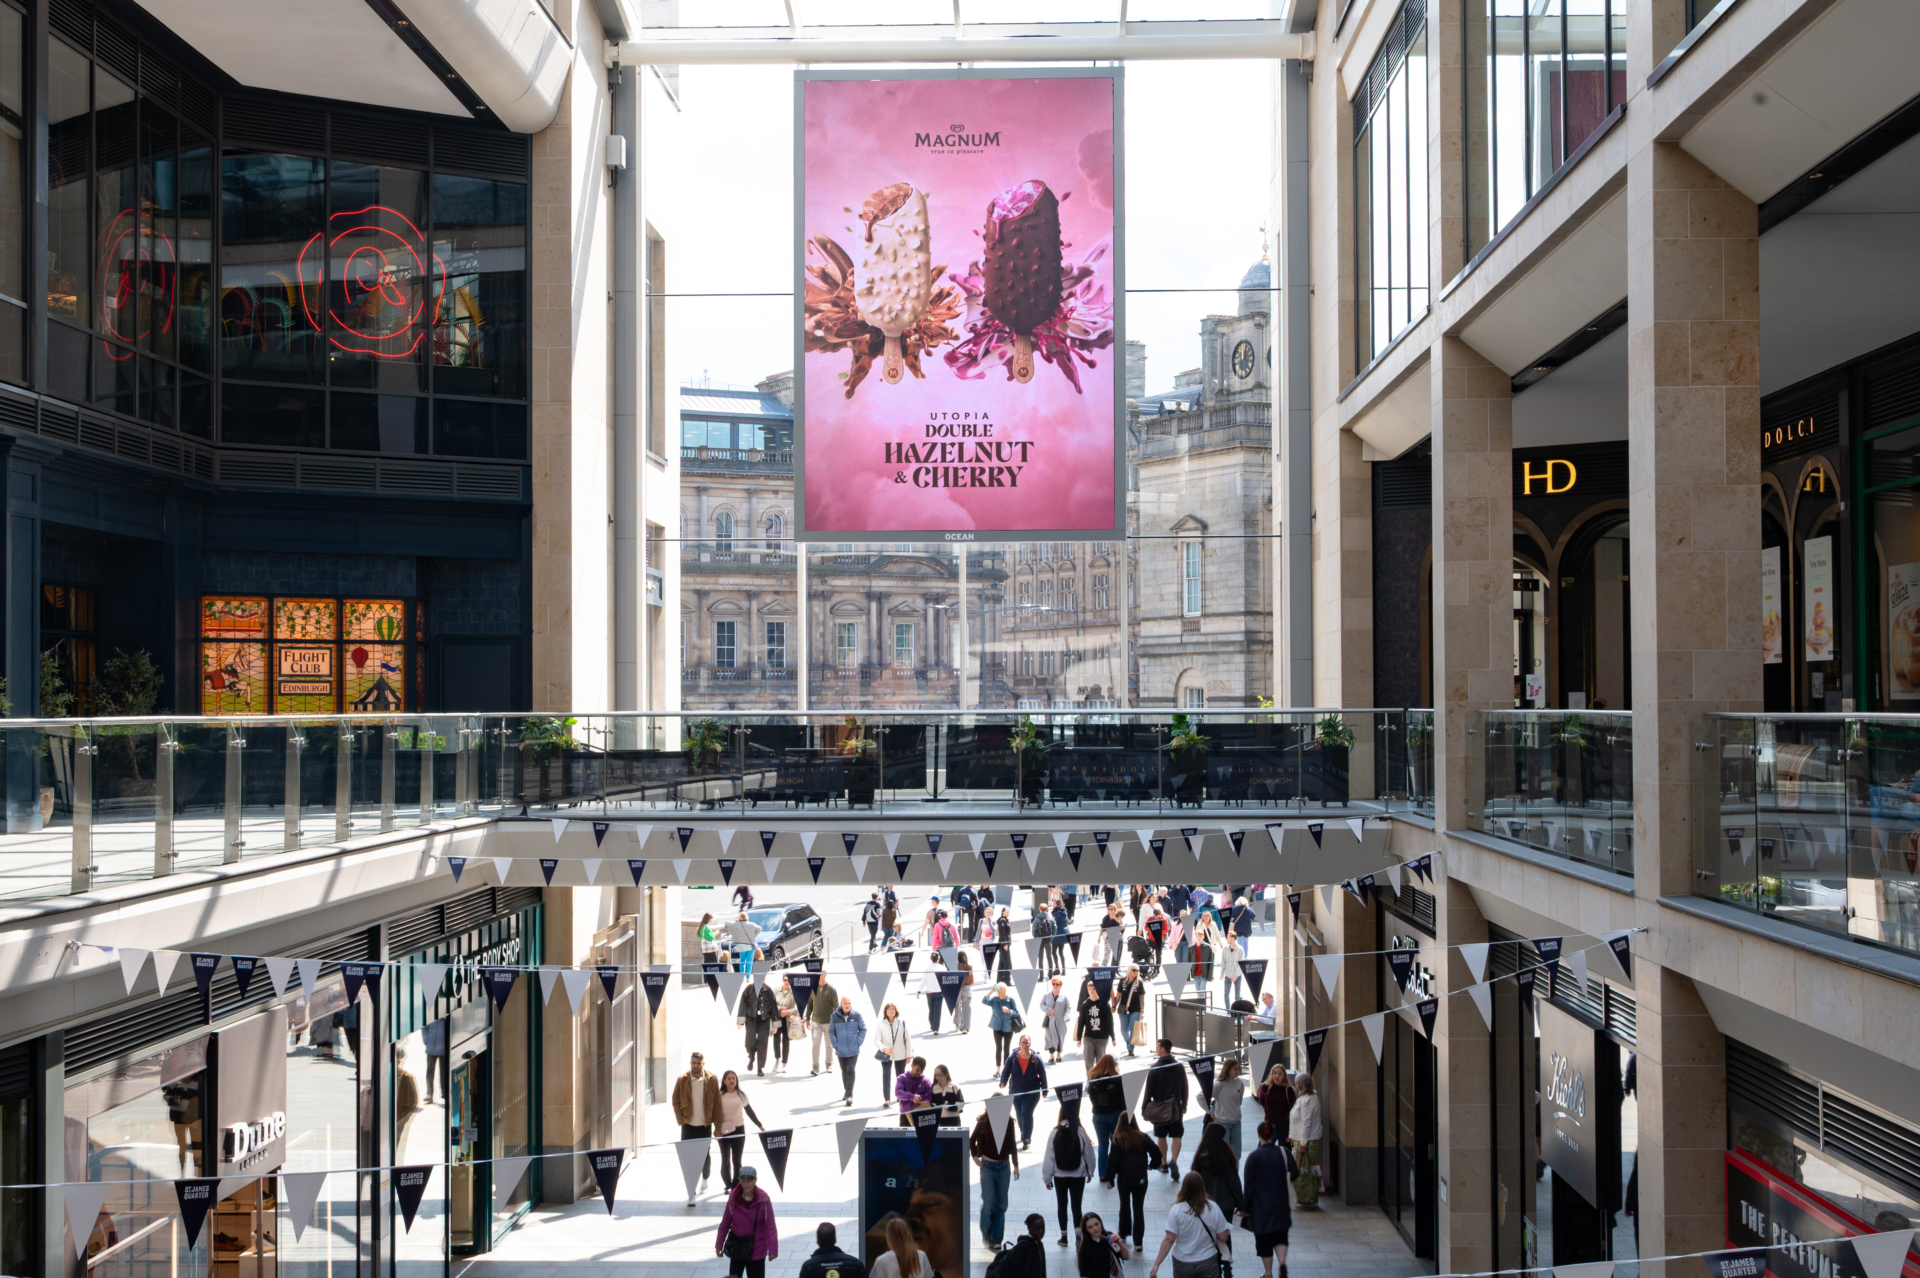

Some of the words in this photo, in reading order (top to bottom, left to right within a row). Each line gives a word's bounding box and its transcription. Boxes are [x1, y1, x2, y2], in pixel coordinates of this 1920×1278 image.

[915, 131, 1001, 148] MAGNUM
[930, 412, 989, 420] UTOPIA
[925, 424, 993, 437] DOUBLE
[1765, 417, 1814, 448] DOLCI
[884, 442, 1035, 463] HAZELNUT
[894, 471, 908, 484] &
[913, 466, 1024, 488] CHERRY
[1523, 459, 1577, 495] HD
[284, 651, 327, 663] FLIGHT
[290, 662, 321, 673] CLUB
[283, 684, 328, 692] EDINBURGH
[466, 955, 481, 984] THE
[482, 946, 501, 967] BODY
[502, 938, 520, 968] SHOP
[1547, 1050, 1586, 1117] Kiehl's
[232, 1111, 286, 1163] Dune
[239, 1148, 269, 1171] LONDON
[885, 1177, 897, 1188] a
[183, 1191, 209, 1200] QUARTER
[1740, 1200, 1766, 1237] THE
[1772, 1222, 1841, 1278] PERFUME
[1730, 1257, 1755, 1269] JAMES
[1722, 1266, 1757, 1278] QUARTER
